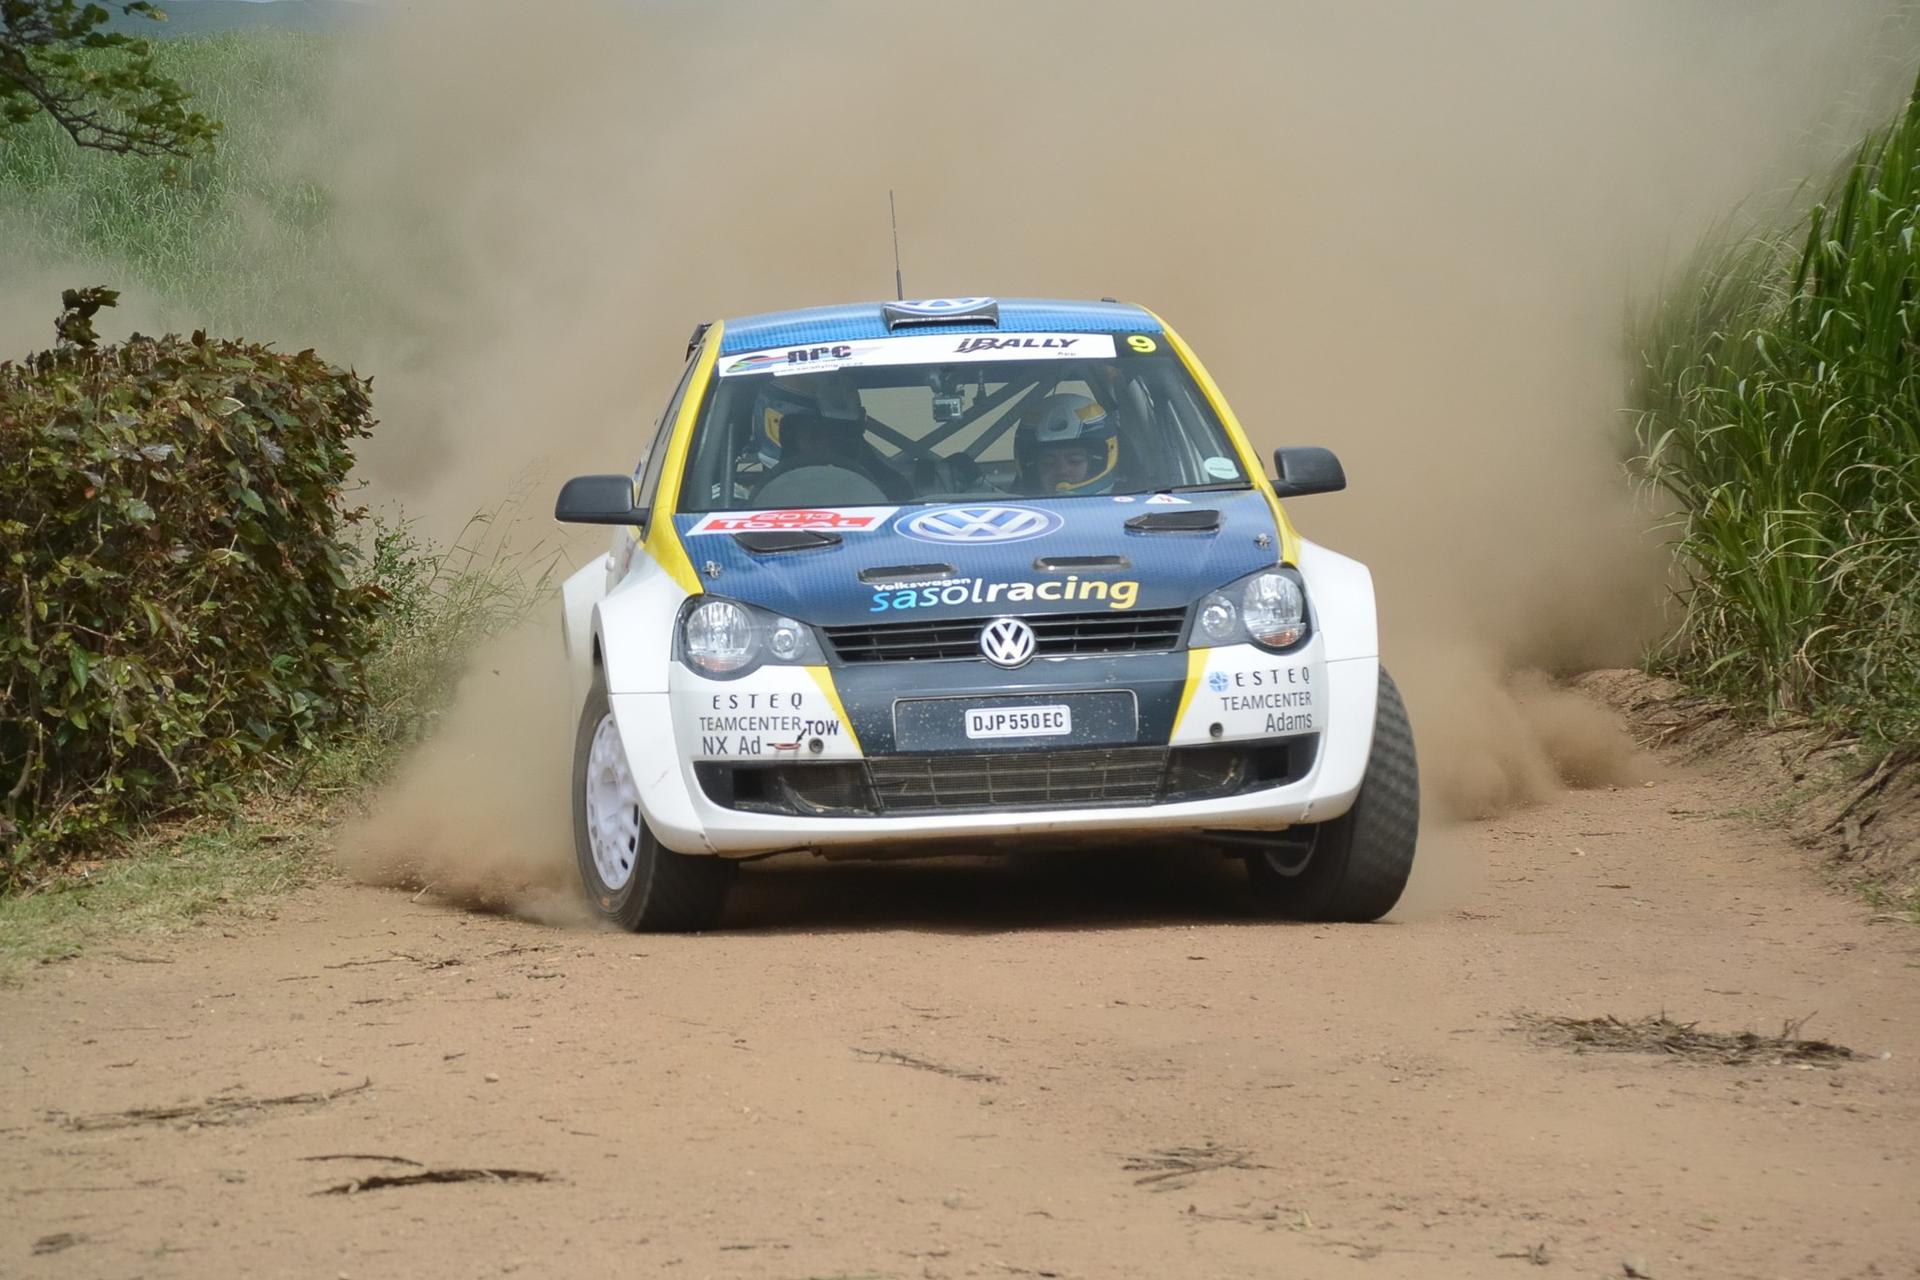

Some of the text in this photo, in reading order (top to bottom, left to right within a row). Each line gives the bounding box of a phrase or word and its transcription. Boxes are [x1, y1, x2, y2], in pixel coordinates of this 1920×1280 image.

[1127, 335, 1157, 353] 9
[719, 518, 856, 529] TOTAL
[757, 512, 834, 520] 2013
[873, 577, 971, 592] Volkswagen
[1235, 666, 1310, 687] ESTEQ
[713, 693, 802, 709] ESTEQ
[1221, 691, 1312, 711] TEAMCENTER
[700, 717, 801, 731] TEAMCENTER
[805, 720, 839, 736] TOW
[1265, 712, 1312, 733] Adams
[702, 736, 760, 755] NX Ad
